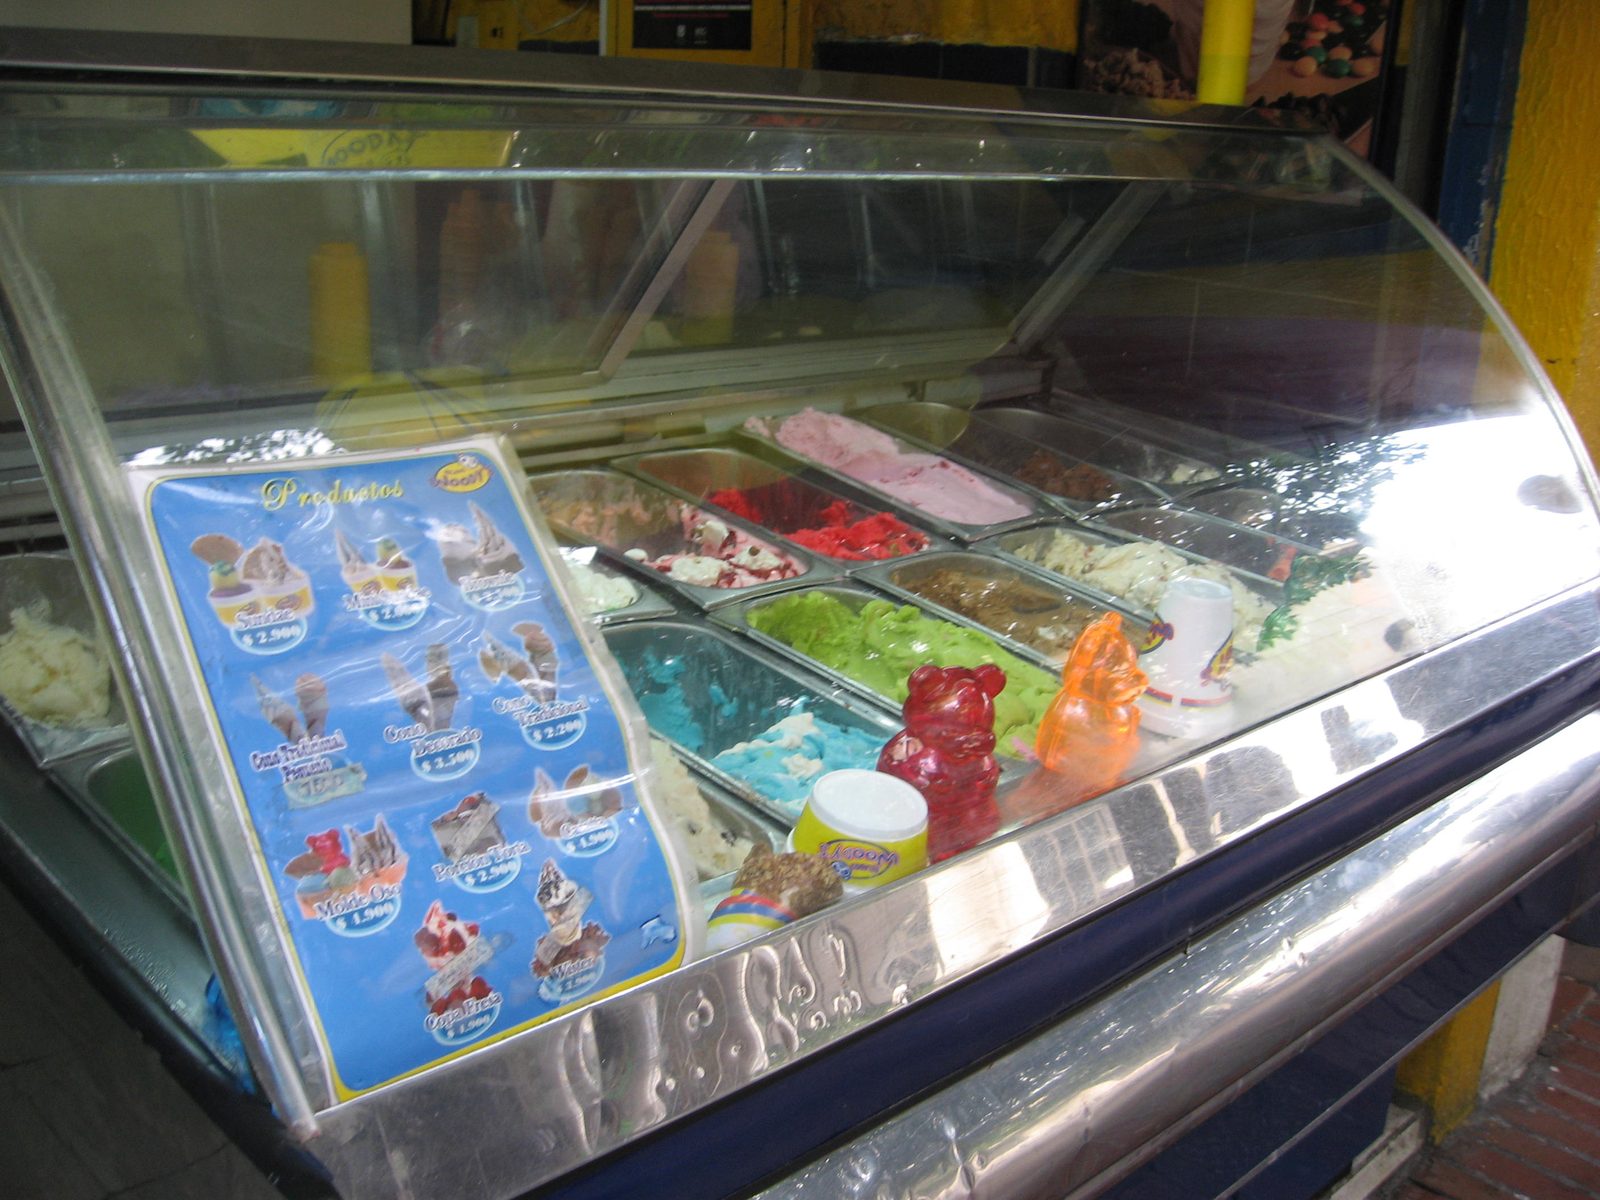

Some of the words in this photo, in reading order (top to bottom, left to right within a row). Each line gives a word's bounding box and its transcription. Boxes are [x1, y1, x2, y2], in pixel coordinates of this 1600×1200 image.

[261, 477, 404, 511] Productos
[384, 722, 427, 744] Cono
[312, 892, 368, 921] Molde
